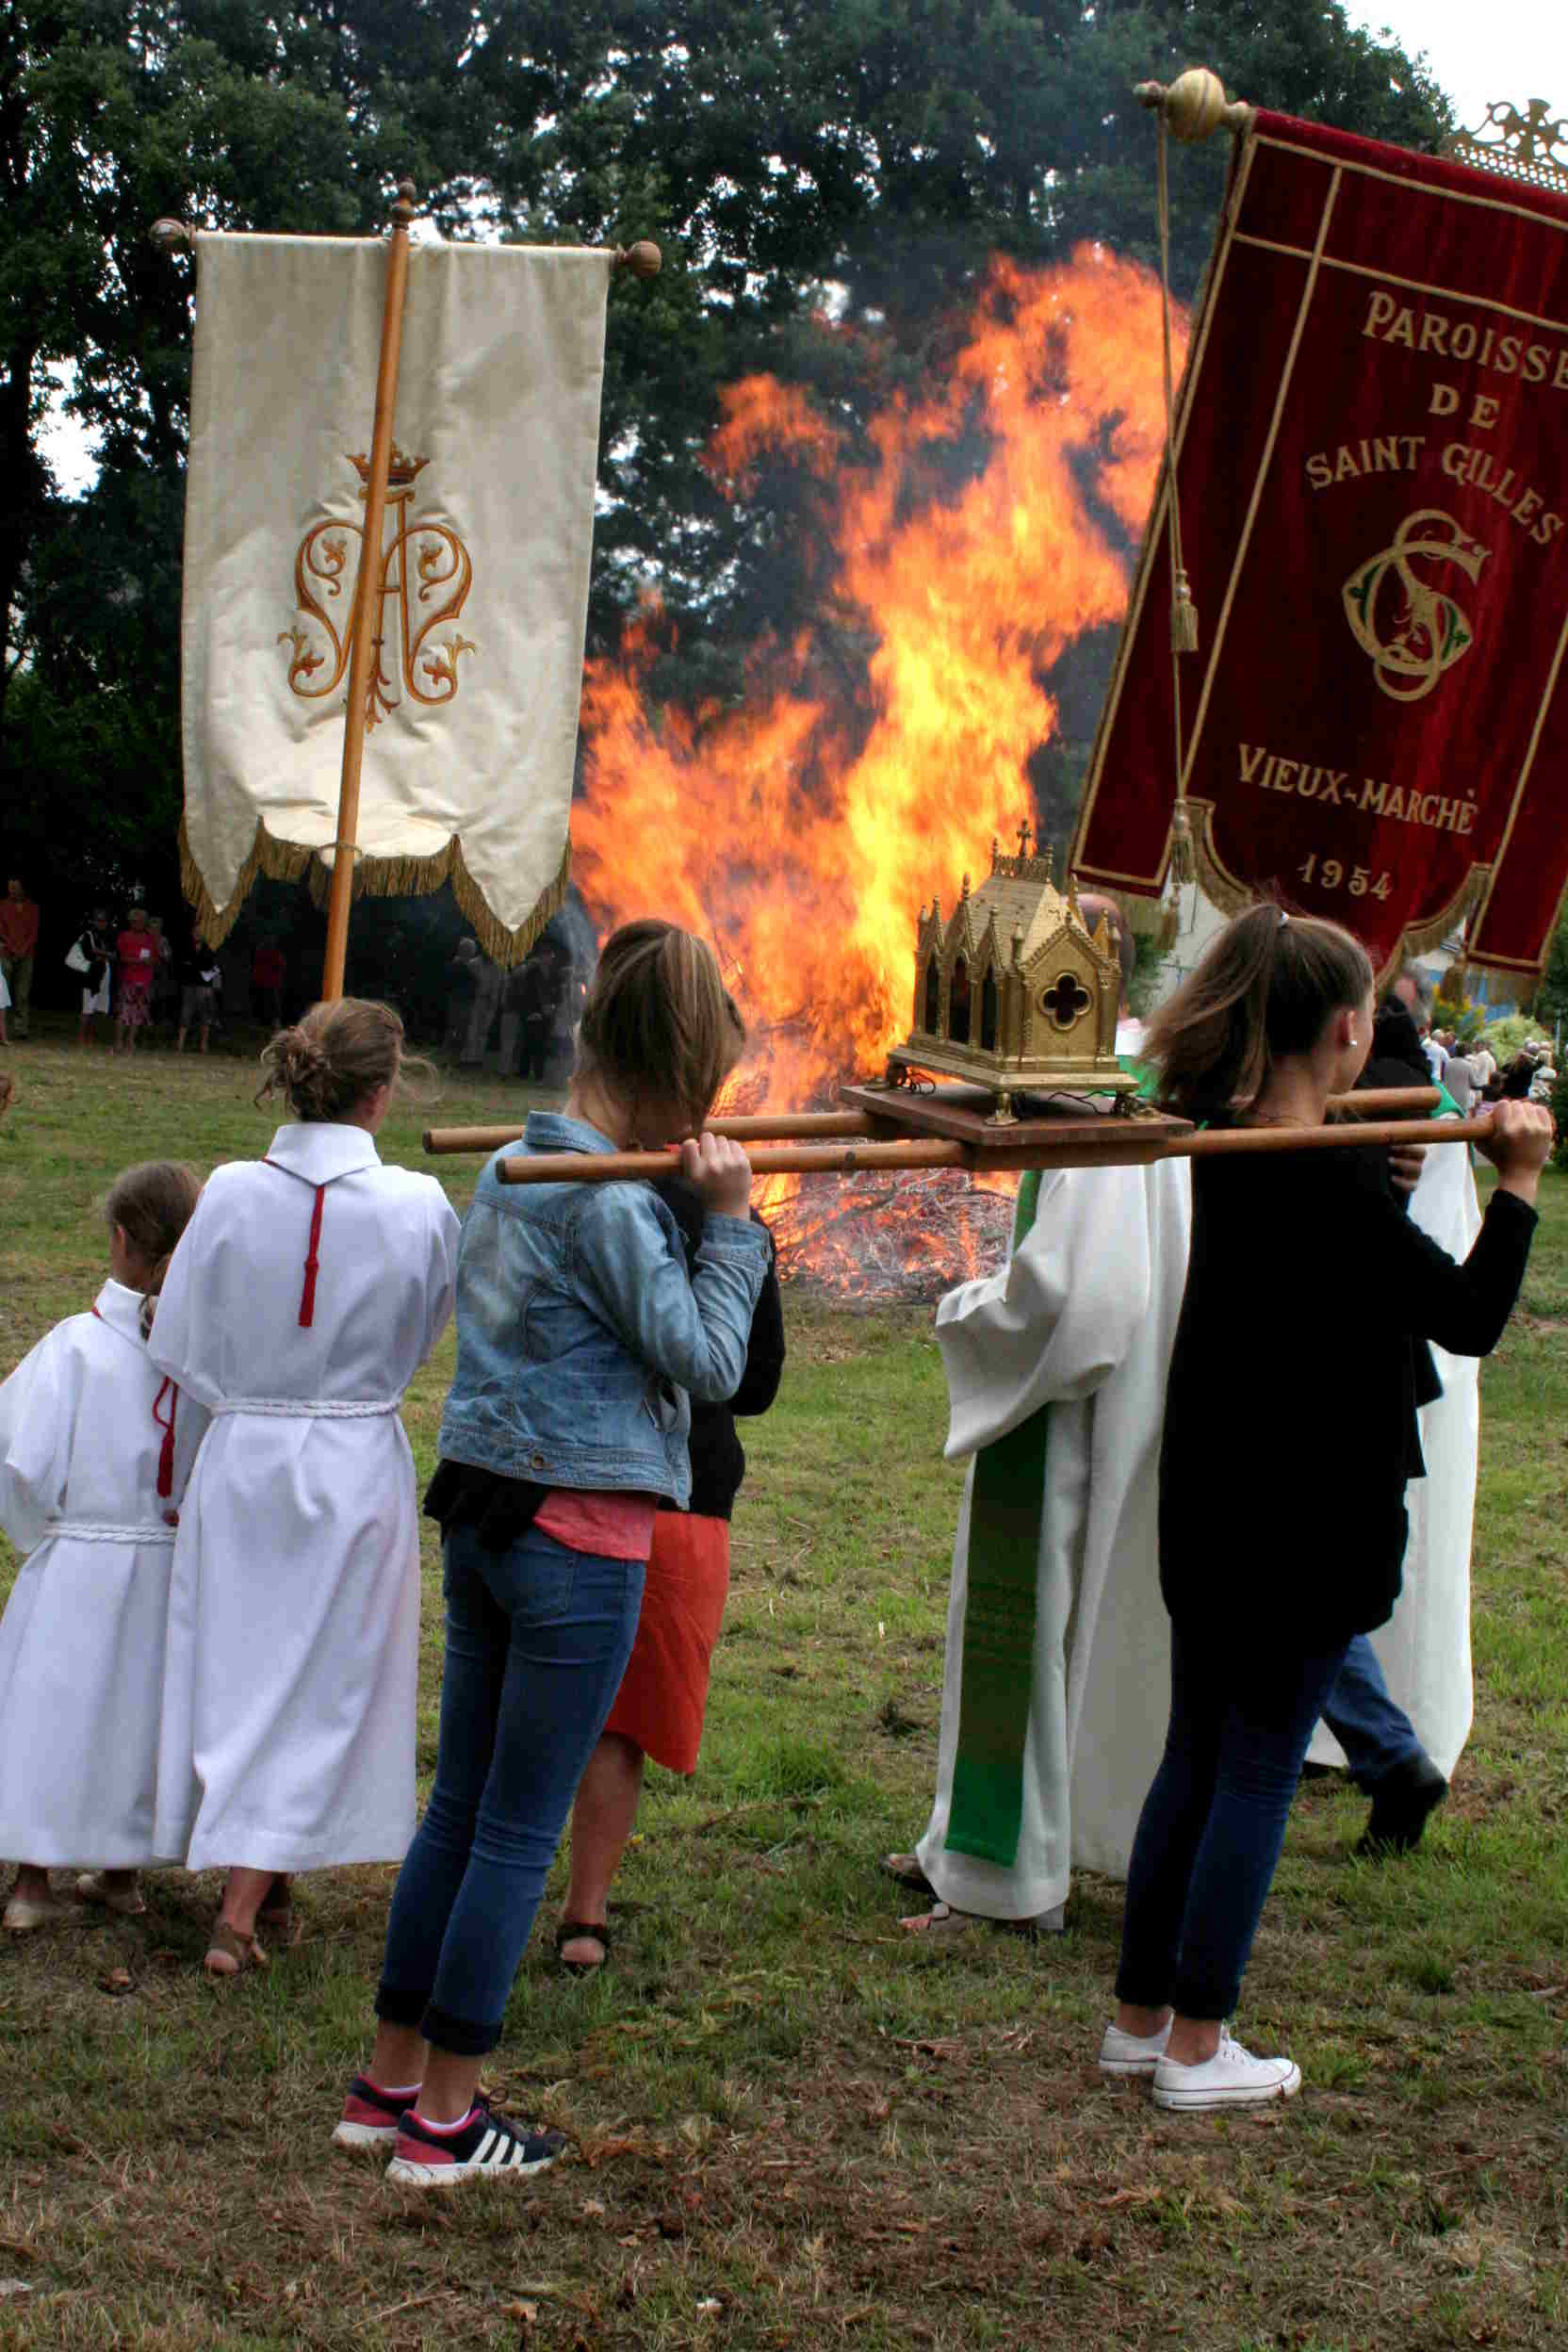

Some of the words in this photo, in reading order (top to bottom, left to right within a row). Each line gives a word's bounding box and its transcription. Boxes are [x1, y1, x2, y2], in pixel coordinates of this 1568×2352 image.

[1428, 383, 1499, 429] DE
[1305, 435, 1425, 490] SAINT
[1442, 443, 1564, 544] GILLES
[1297, 853, 1393, 901] 1954
